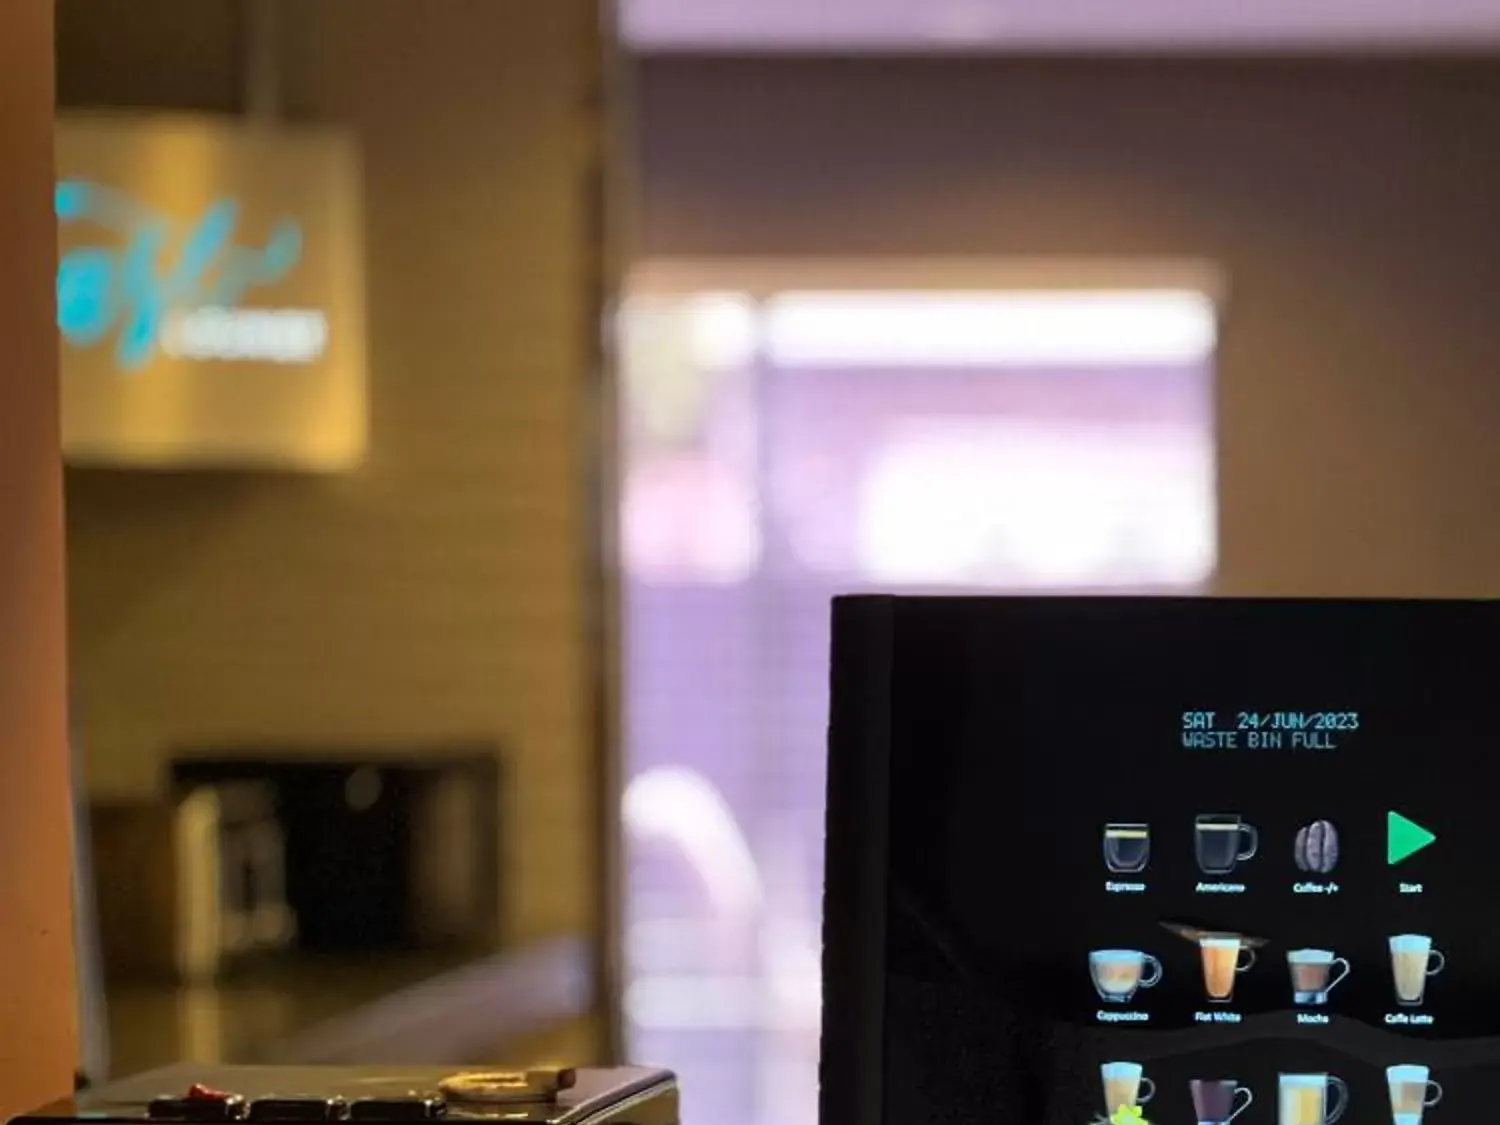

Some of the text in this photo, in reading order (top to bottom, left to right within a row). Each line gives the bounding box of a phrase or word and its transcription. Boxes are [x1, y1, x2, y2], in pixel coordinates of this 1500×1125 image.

[1182, 711, 1359, 729] SAT 24/JUN/2023
[1182, 731, 1337, 749] WASTE BIN FULL
[1399, 883, 1423, 893] Start
